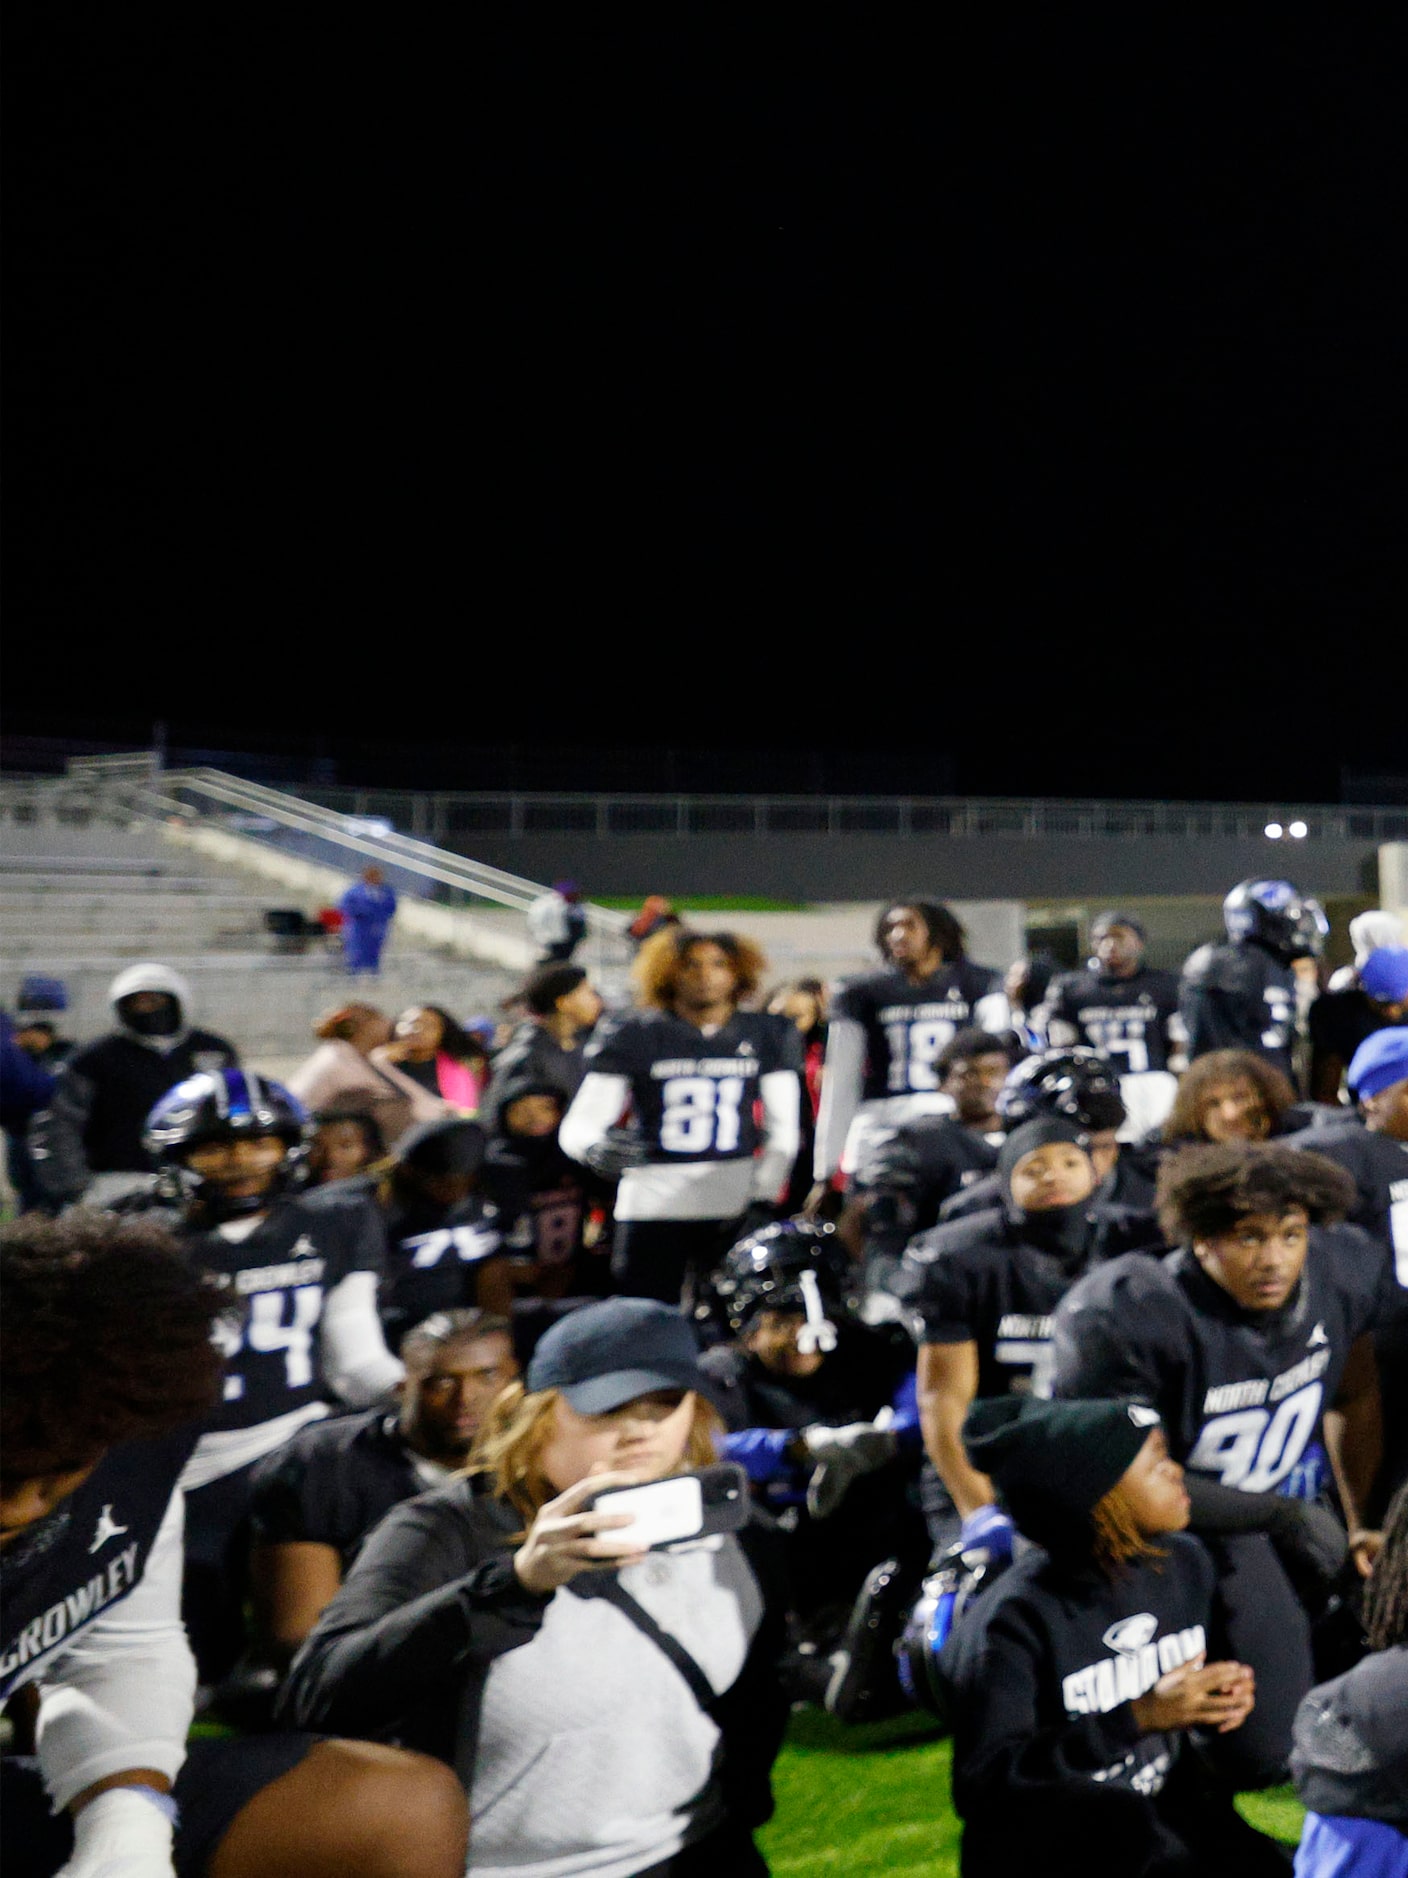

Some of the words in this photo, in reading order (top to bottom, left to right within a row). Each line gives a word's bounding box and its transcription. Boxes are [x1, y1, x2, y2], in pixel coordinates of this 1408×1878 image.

[659, 1077, 745, 1153] 81
[1187, 1378, 1323, 1494] 90
[0, 1541, 139, 1679] CROWLEY
